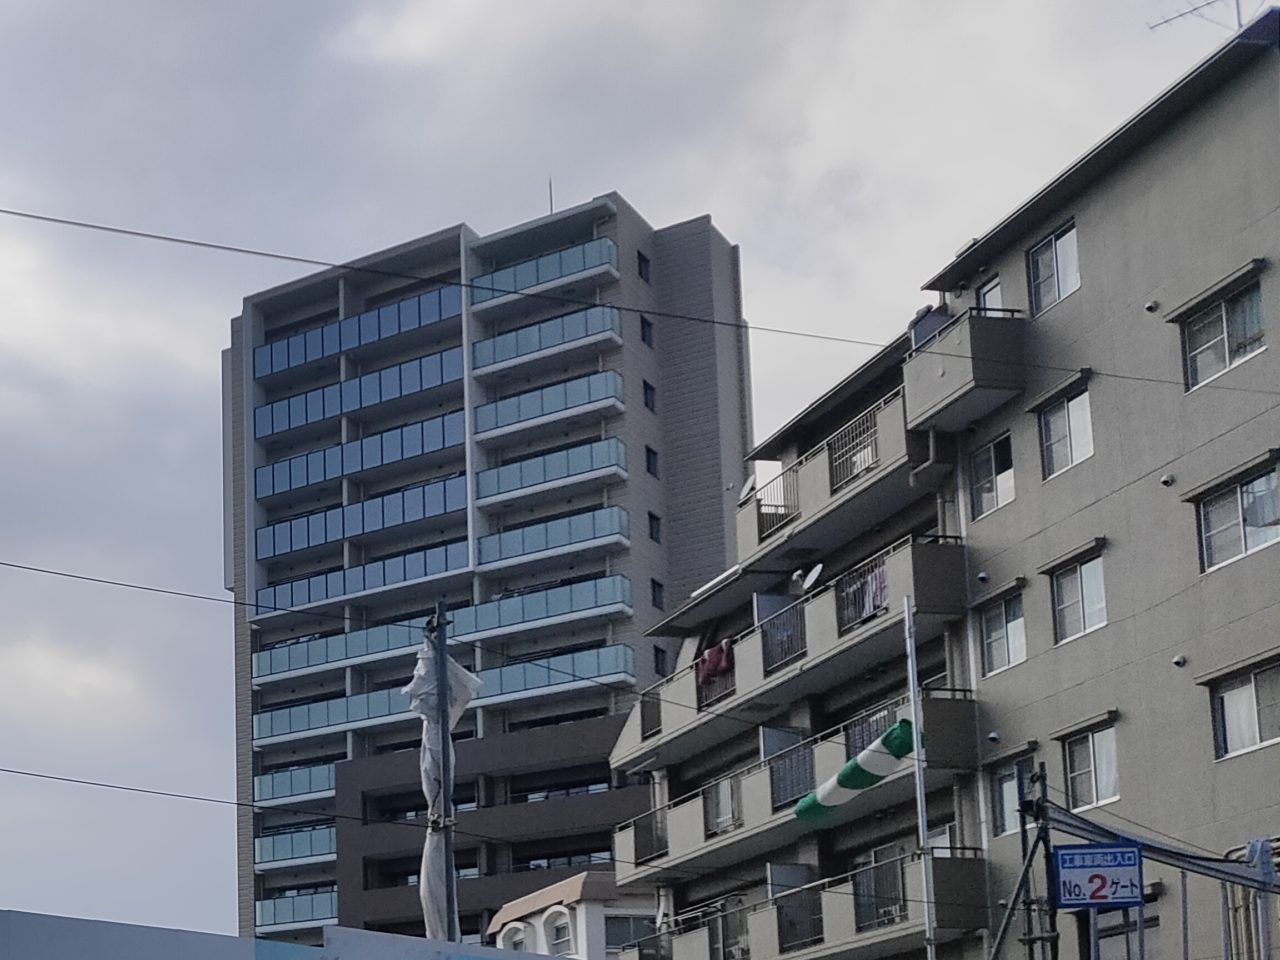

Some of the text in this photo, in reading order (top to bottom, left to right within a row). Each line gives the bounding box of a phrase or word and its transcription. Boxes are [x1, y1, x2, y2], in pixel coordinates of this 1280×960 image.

[1062, 873, 1138, 900] No. 2 ゲート
